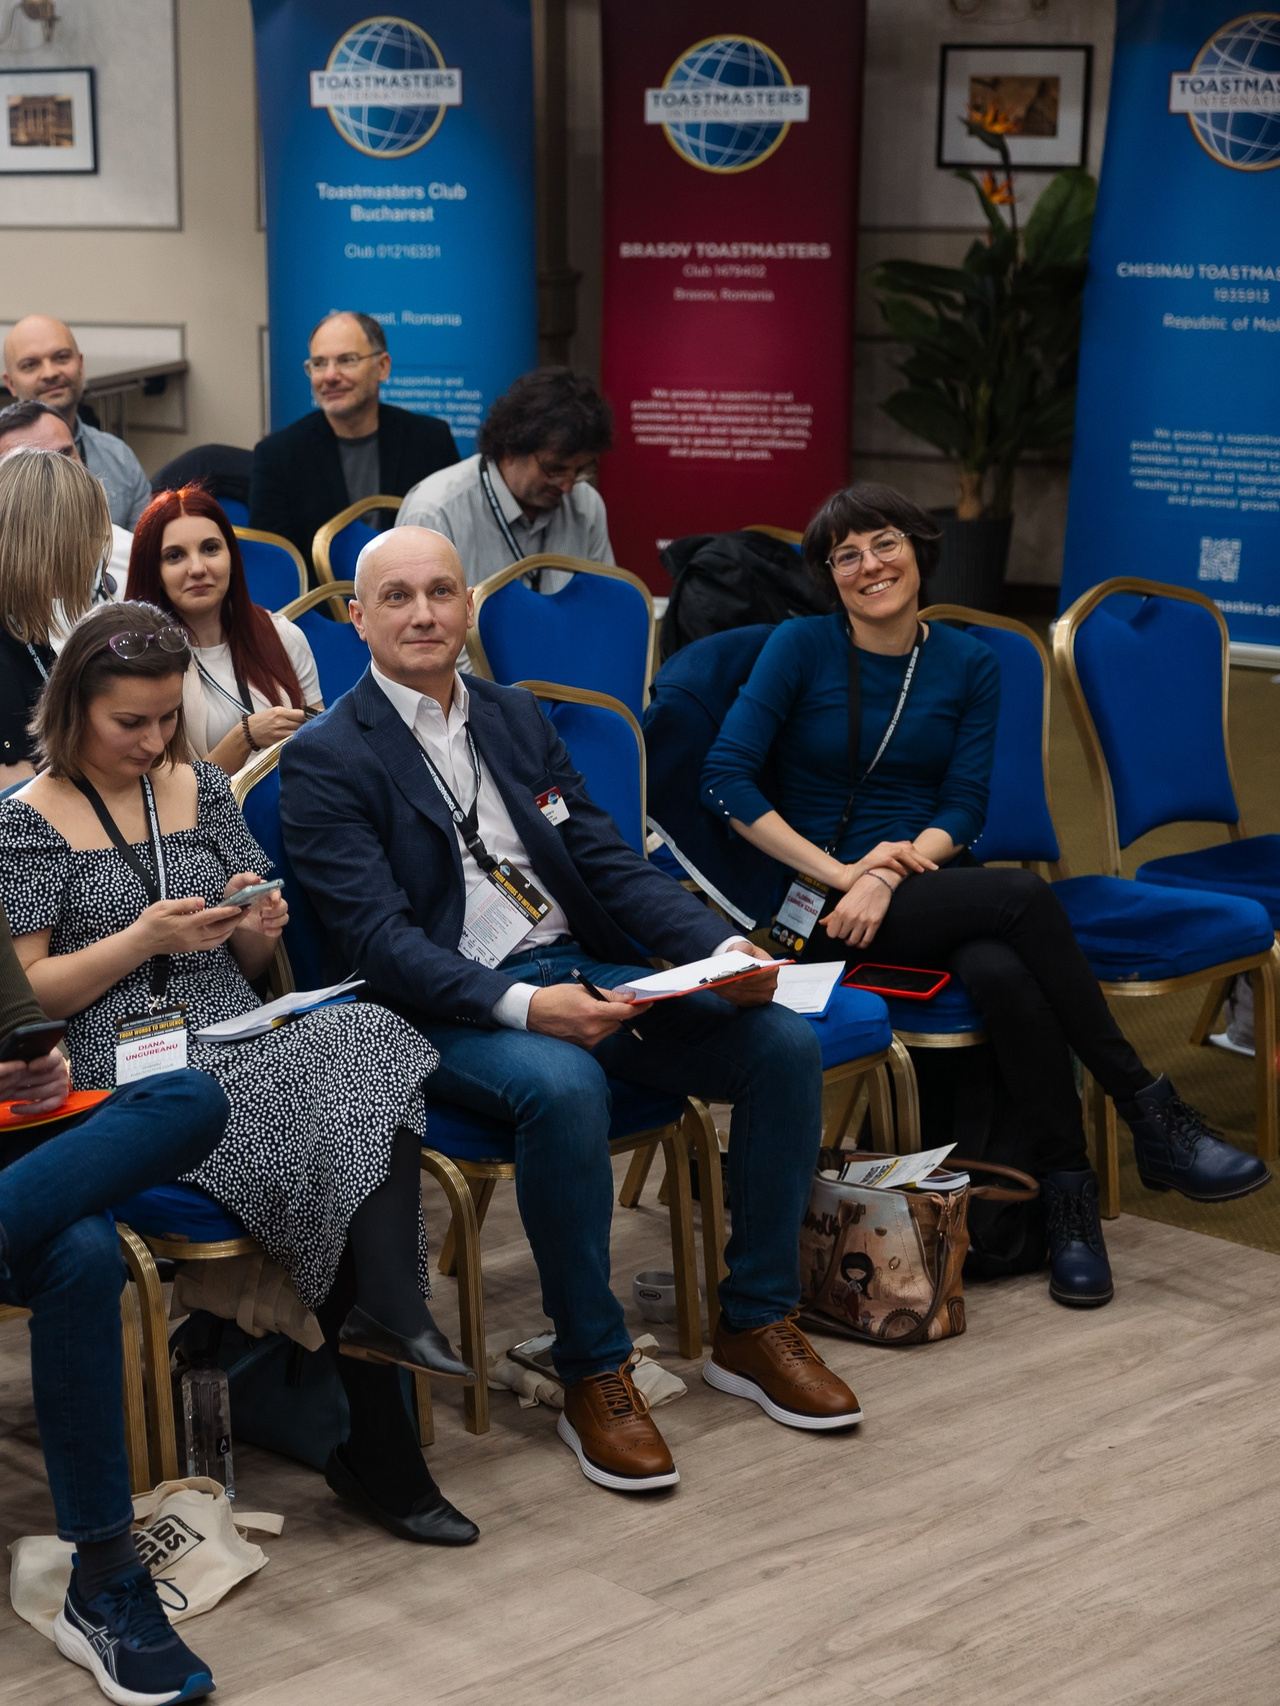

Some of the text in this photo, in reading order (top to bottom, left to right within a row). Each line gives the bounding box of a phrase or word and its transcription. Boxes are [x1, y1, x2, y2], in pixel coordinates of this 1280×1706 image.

[317, 74, 457, 90] TOASTMASTERS
[652, 90, 804, 108] TOASTMASTERS
[317, 182, 467, 200] Toastmasters Club
[350, 205, 434, 222] Bucharest
[344, 244, 374, 258] Club
[620, 242, 831, 259] BRASOV TOASTMASTERS
[682, 264, 712, 277] Club
[1116, 262, 1194, 280] CHISINAU
[720, 287, 775, 302] Romania
[401, 311, 462, 326] Romania
[1162, 313, 1228, 332] Republic
[1232, 314, 1250, 332] of
[120, 1030, 133, 1039] FROM
[134, 1026, 151, 1035] WORDS
[159, 1018, 184, 1030] INFLUENCE
[125, 1044, 179, 1061] UNGUREANU
[138, 1040, 165, 1051] DIANA
